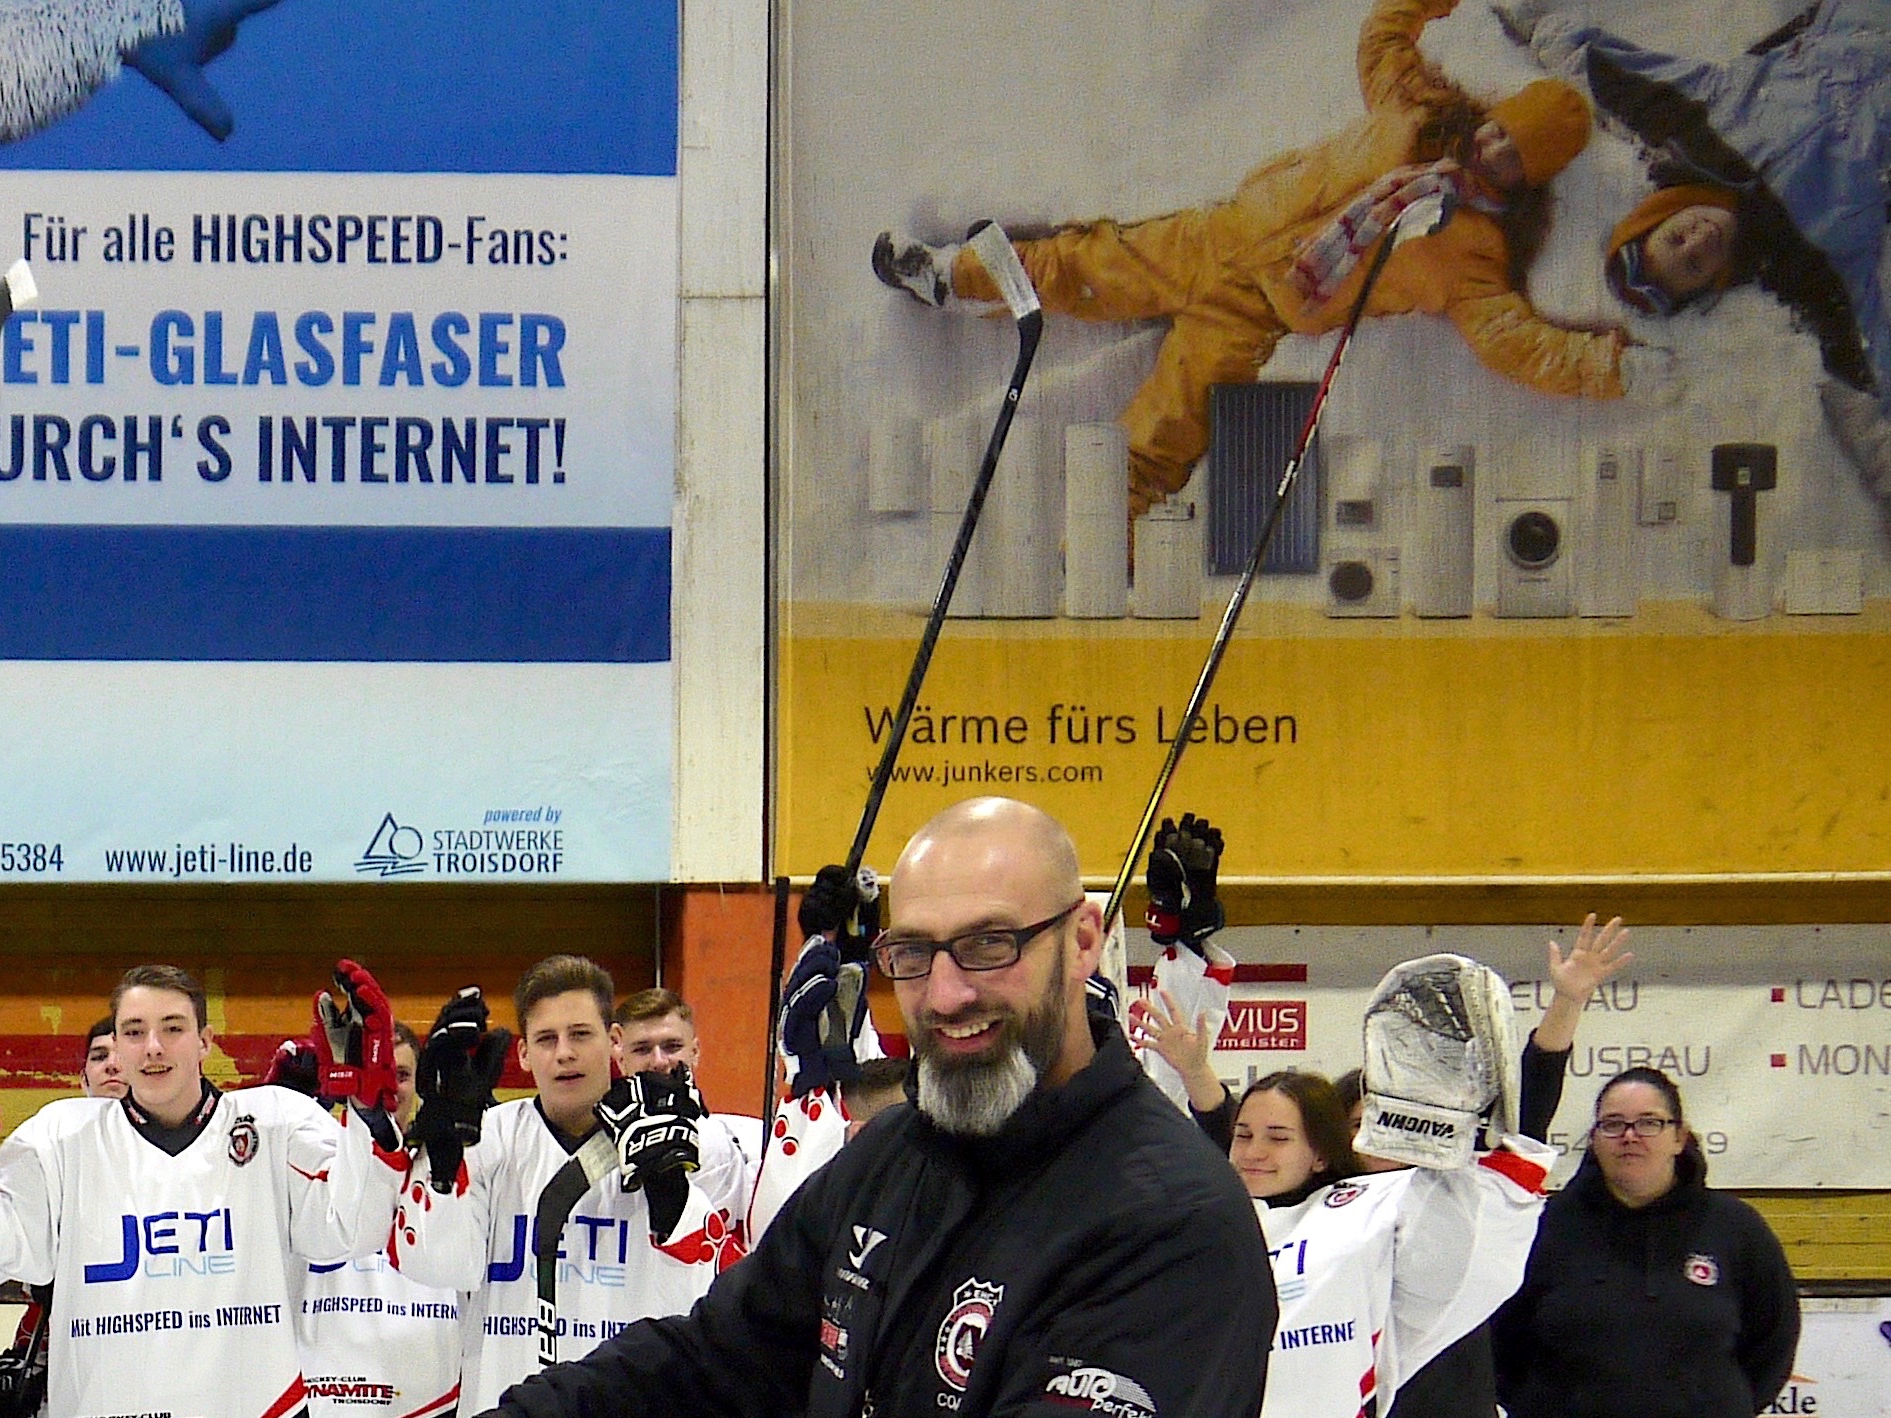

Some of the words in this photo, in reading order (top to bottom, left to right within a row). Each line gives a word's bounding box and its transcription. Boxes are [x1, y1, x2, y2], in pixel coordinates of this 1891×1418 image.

[23, 213, 88, 262] Für
[102, 213, 175, 263] alle
[192, 214, 568, 265] HIGHSPEED-Fans:
[258, 416, 567, 485] INTERNET!
[863, 705, 1029, 744] Wärme
[1048, 704, 1137, 744] fürs
[1157, 704, 1298, 745] Leben
[484, 807, 541, 825] powered
[544, 806, 563, 825] by
[433, 830, 564, 851] STADTWERKE
[0, 843, 64, 872] 5384
[105, 843, 313, 878] www.jeti-line.de
[433, 853, 564, 874] TROISDORF
[84, 1208, 234, 1284] JETI
[144, 1254, 236, 1278] LINE
[387, 1300, 407, 1316] ins
[96, 1310, 184, 1335] HIGHSPEED
[189, 1310, 212, 1329] ins
[484, 1315, 567, 1337] HIGHSPD
[573, 1318, 596, 1338] ins
